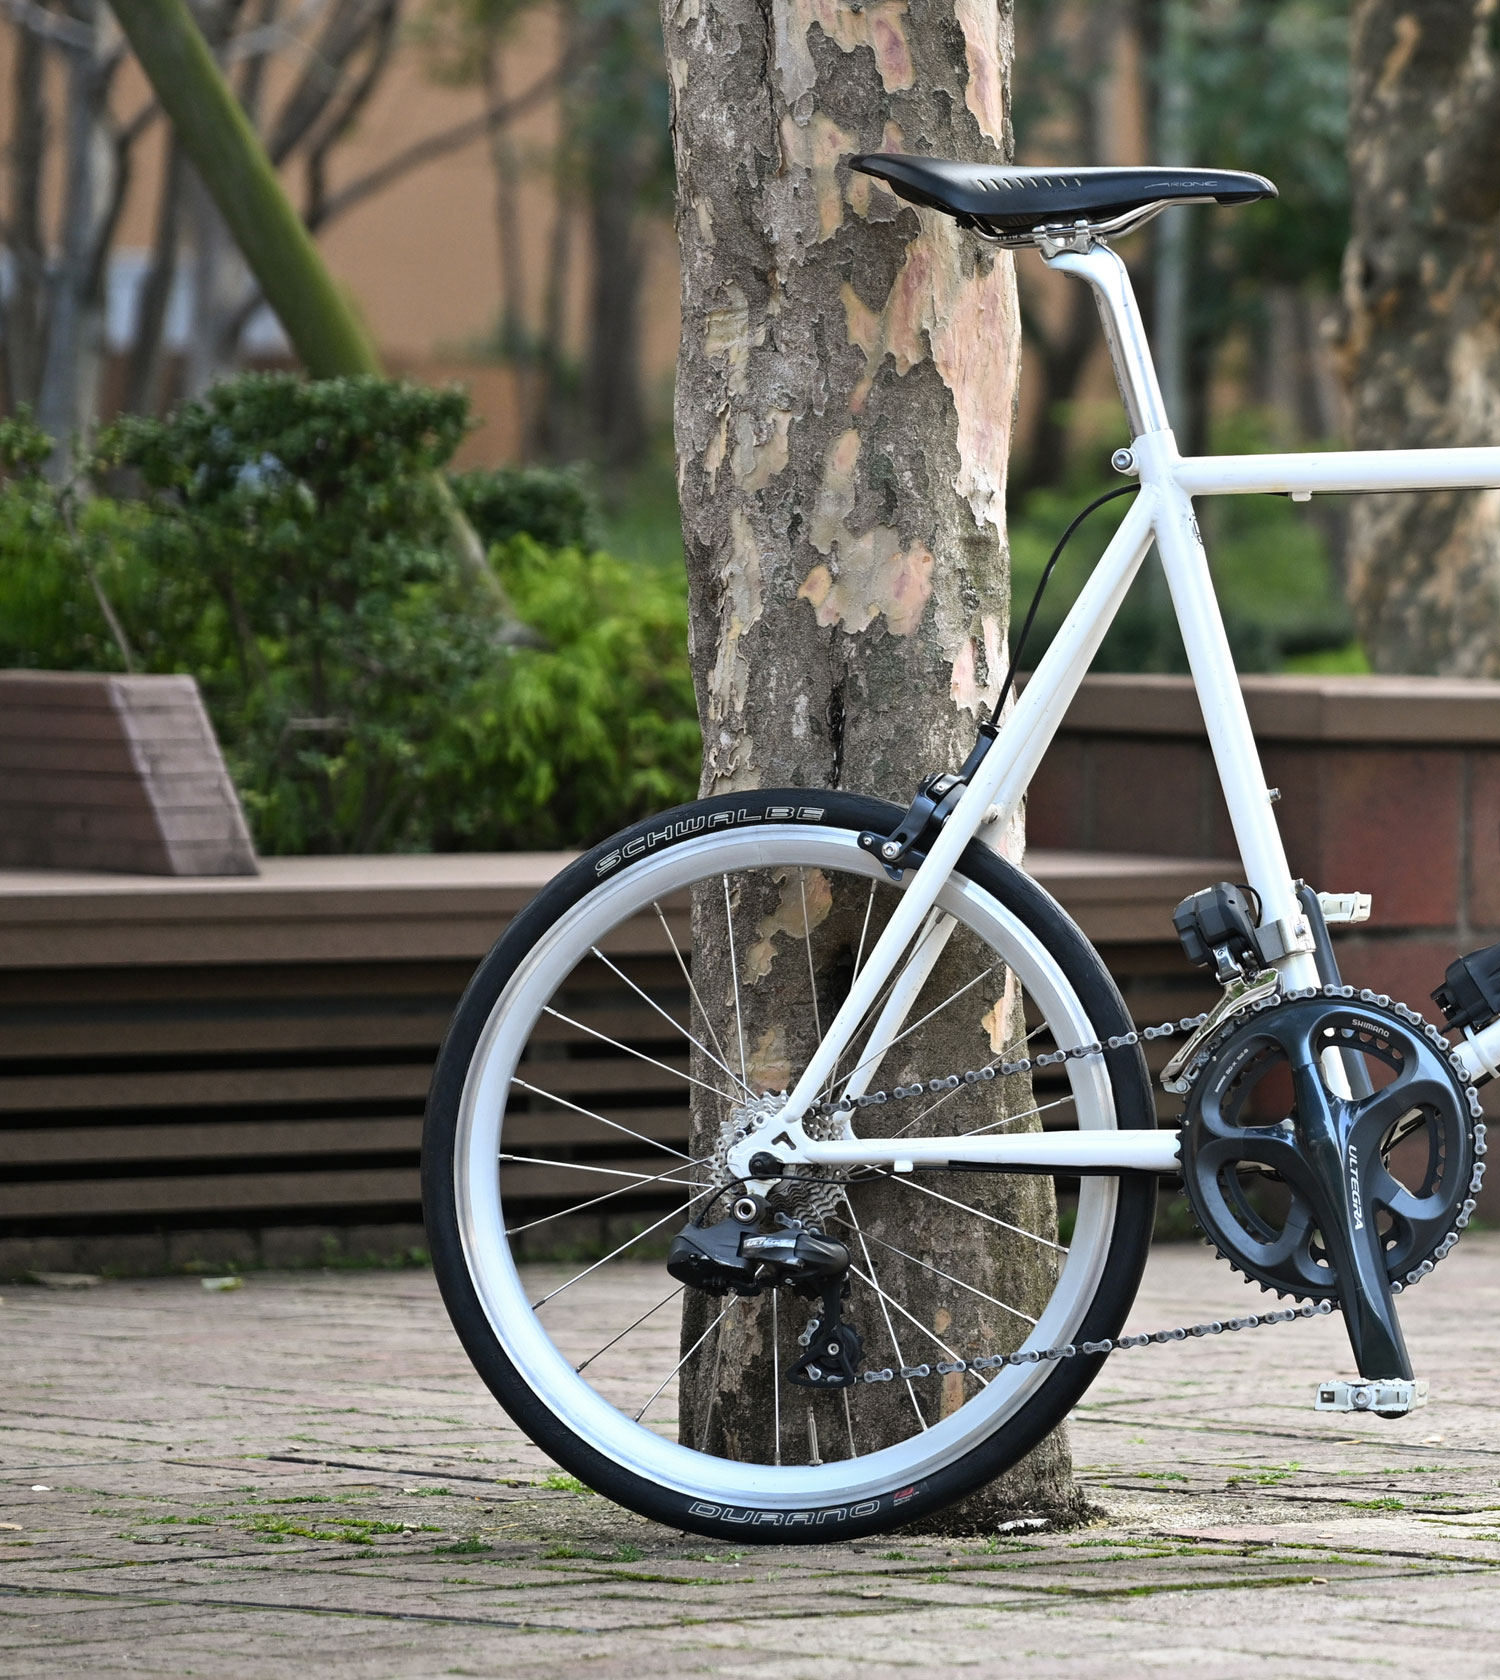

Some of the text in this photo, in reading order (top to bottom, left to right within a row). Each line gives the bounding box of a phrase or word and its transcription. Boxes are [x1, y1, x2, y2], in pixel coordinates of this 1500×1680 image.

[1143, 180, 1218, 189] ARIONE
[594, 806, 825, 878] SCHWALBE
[1351, 1018, 1390, 1038] SHIMANO
[1348, 1144, 1364, 1231] ULTEGRA
[688, 1500, 880, 1526] DURANO
